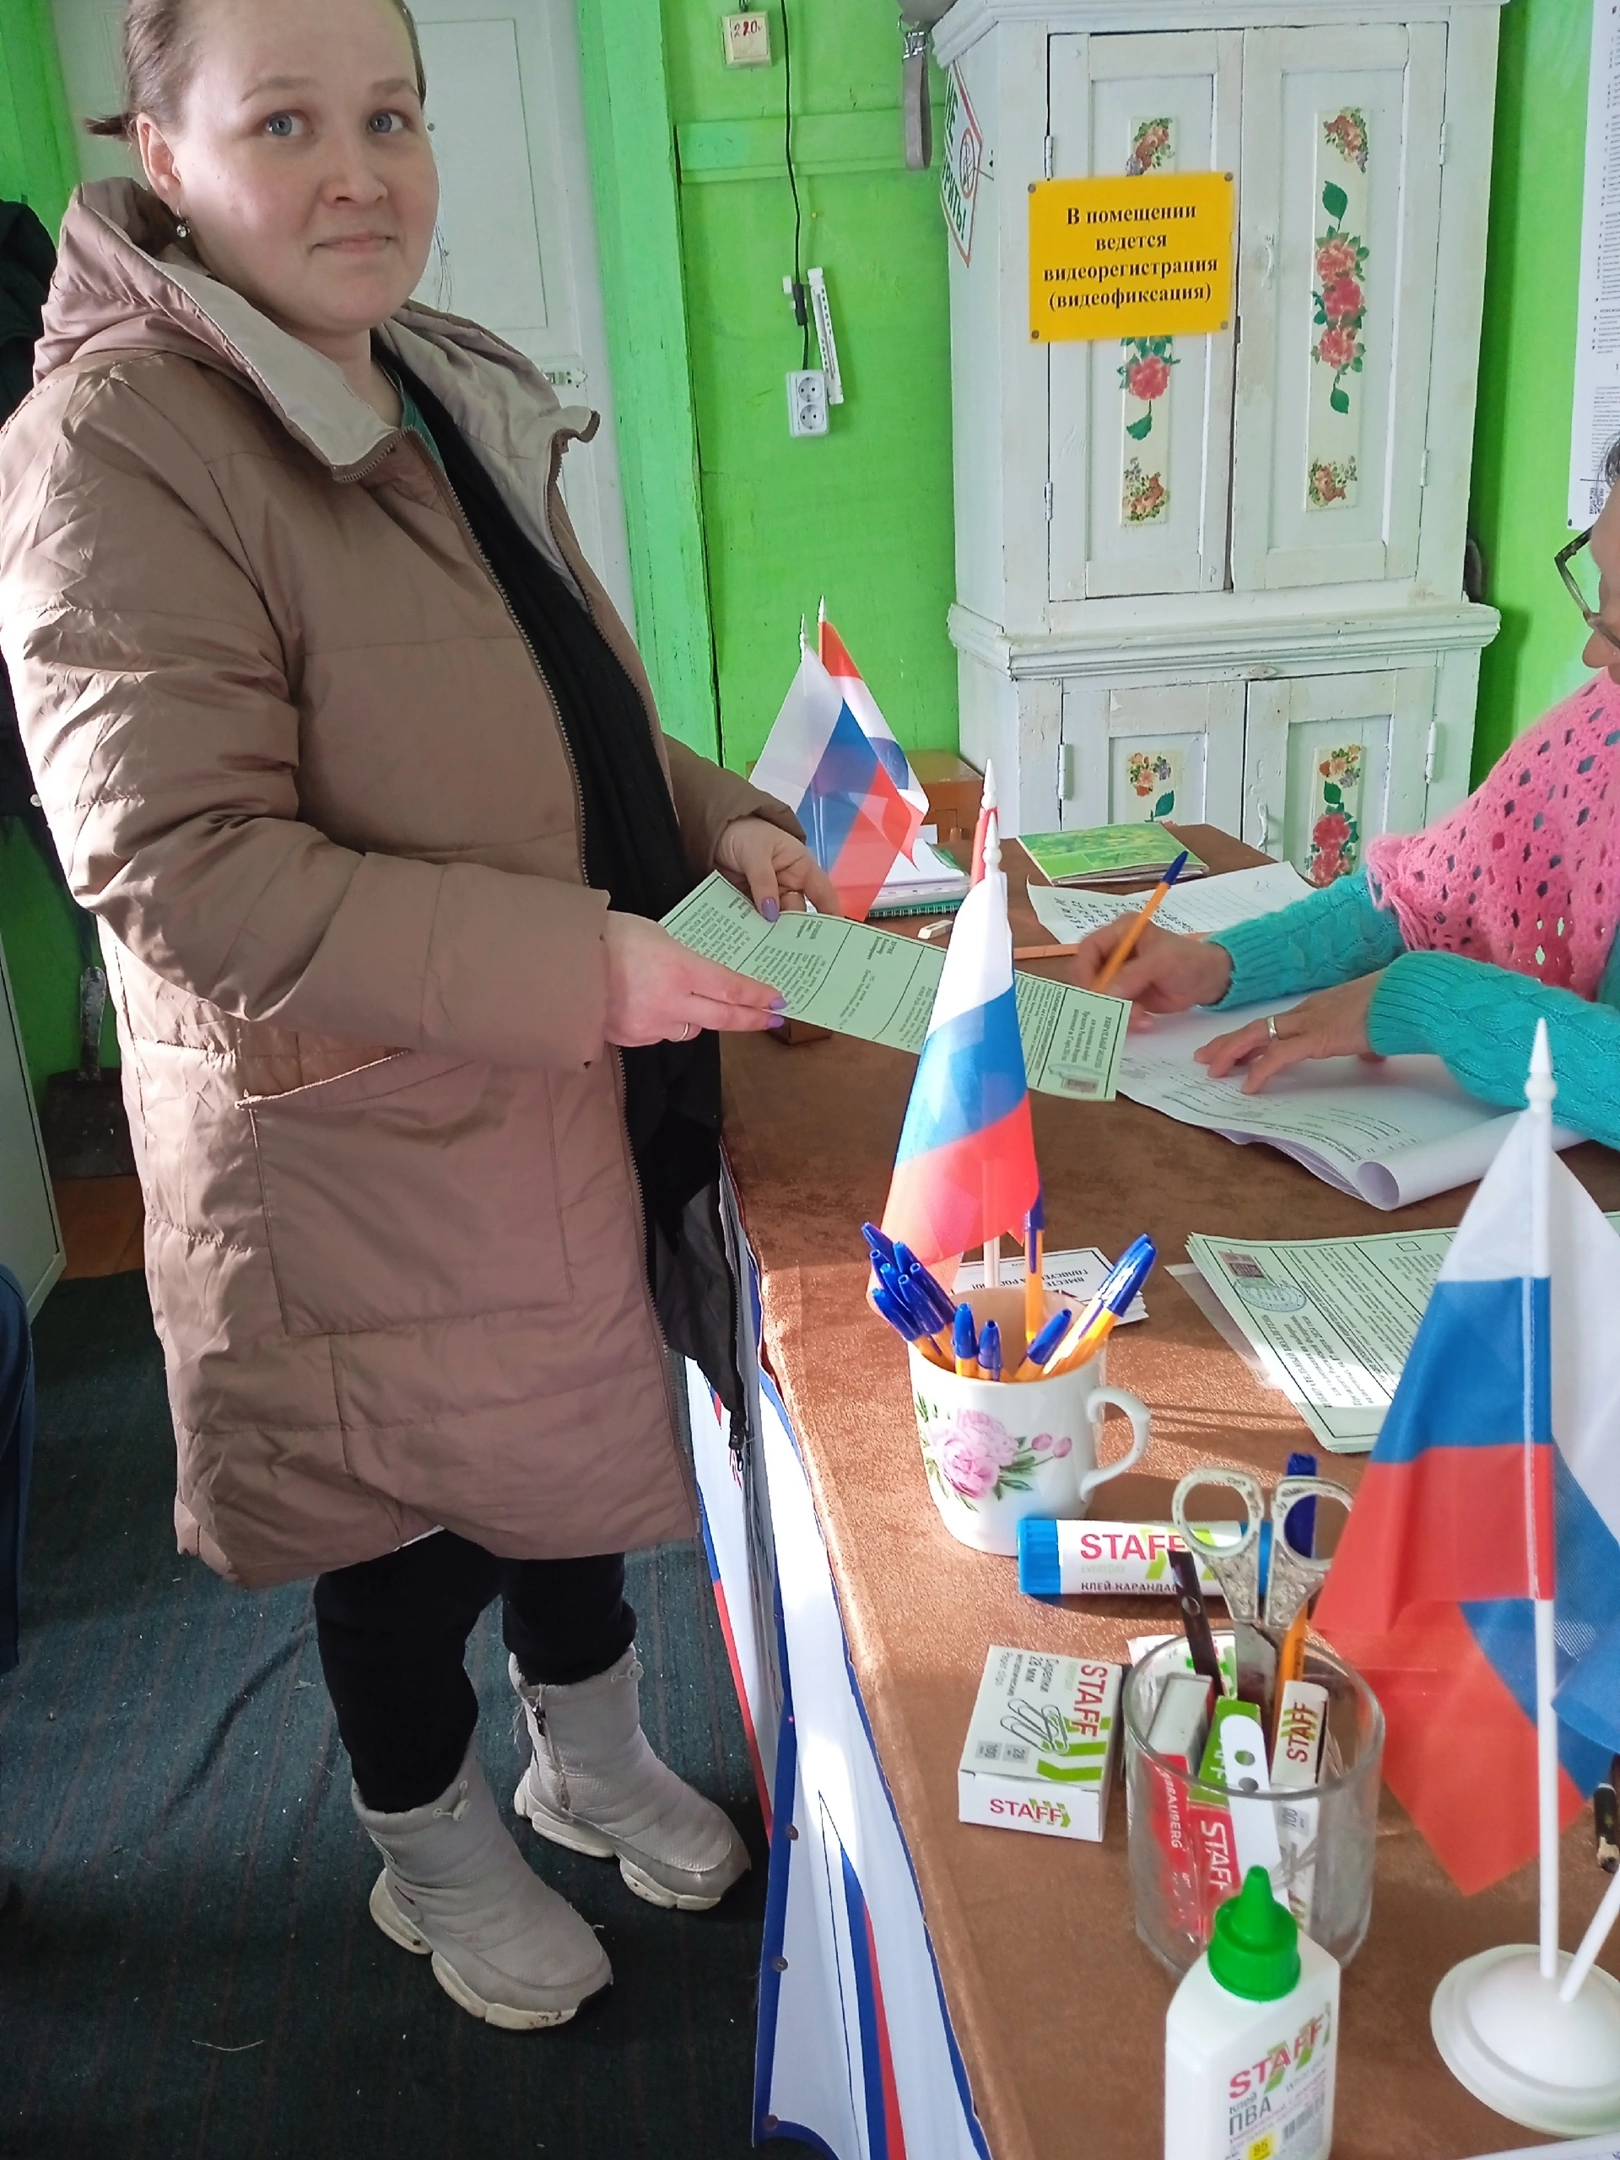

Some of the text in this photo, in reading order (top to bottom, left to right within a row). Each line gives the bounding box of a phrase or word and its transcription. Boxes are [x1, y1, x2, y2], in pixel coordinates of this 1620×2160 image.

[1067, 204, 1197, 226] В помещении
[1095, 233, 1167, 252] ведется
[1043, 258, 1218, 283] видеорегистрация
[1049, 282, 1212, 312] (видеофиксация)
[1080, 1533, 1187, 1561] STAFF
[1071, 1663, 1109, 1738] STAFF
[1286, 1702, 1318, 1763] STAFF
[989, 1798, 1063, 1823] STAFF
[1229, 2013, 1325, 2099] STAFF
[1229, 2095, 1272, 2136] ПВА
